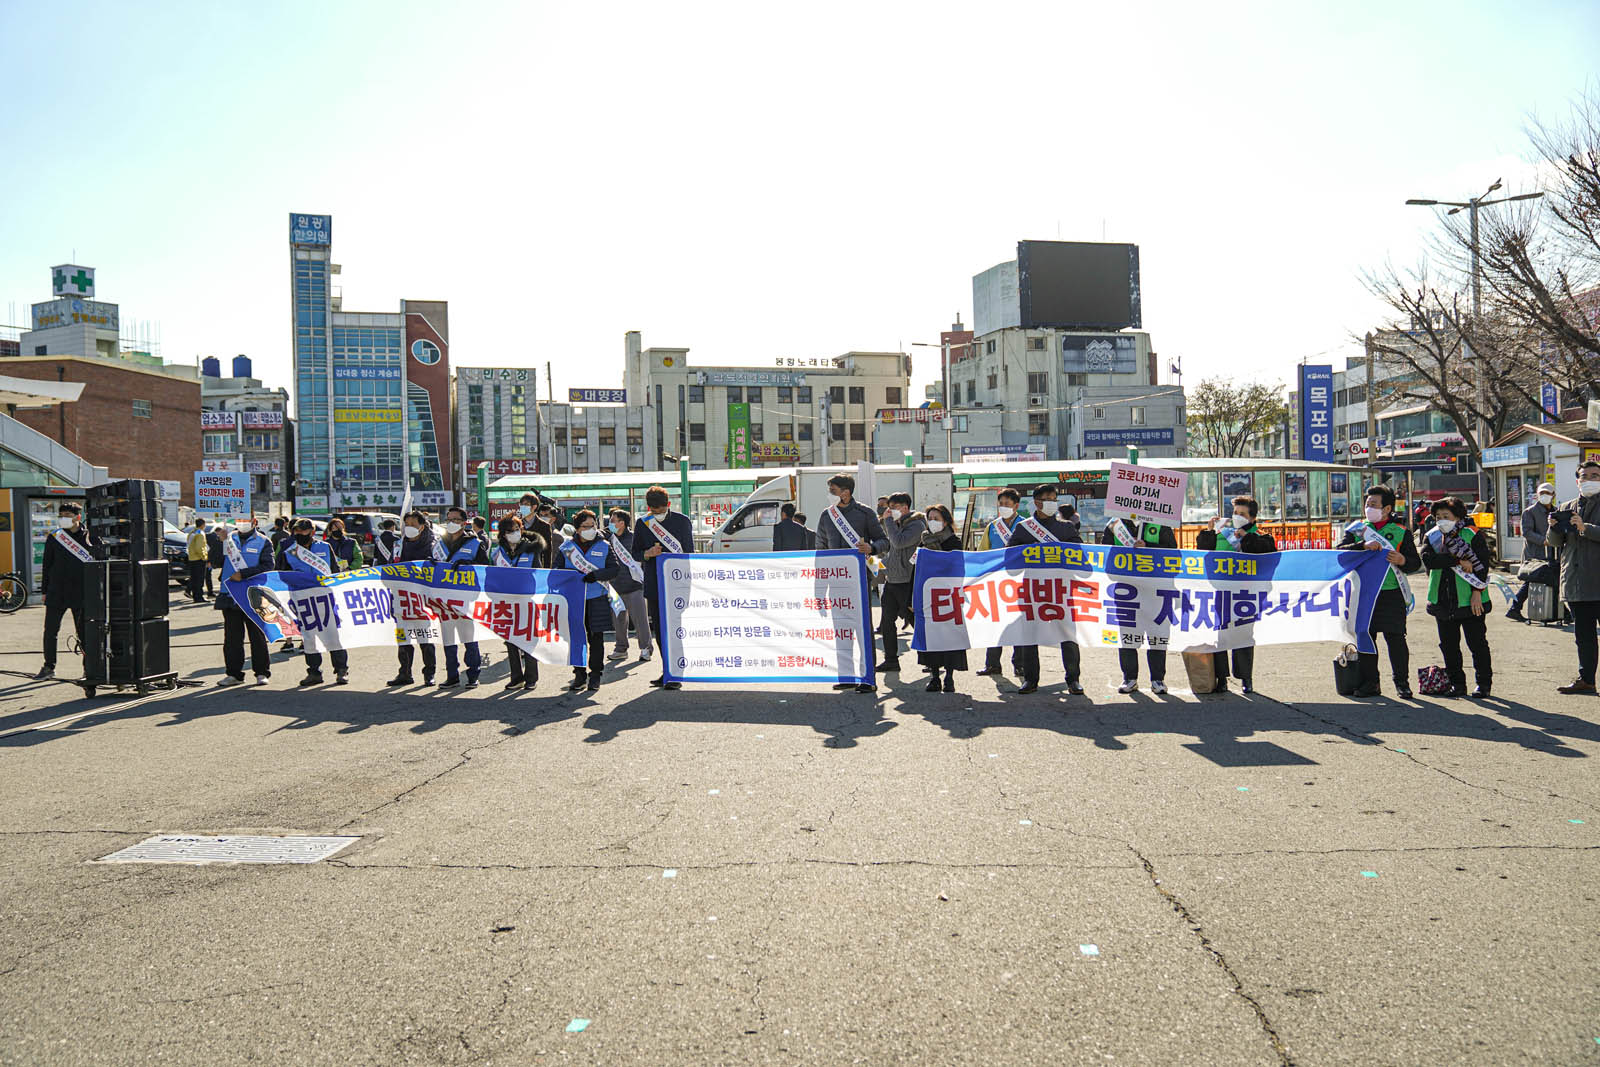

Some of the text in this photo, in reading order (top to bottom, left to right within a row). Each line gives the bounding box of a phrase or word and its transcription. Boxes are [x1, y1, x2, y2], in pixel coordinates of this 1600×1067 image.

[584, 390, 624, 402] 대명장
[1311, 387, 1328, 454] 목포역
[199, 477, 232, 486] 사적모임은
[1117, 468, 1180, 488] 코로나19 확산!
[1132, 485, 1160, 499] 여기서
[710, 503, 733, 515] 택시
[1114, 495, 1174, 515] 막아야 합니다.
[1022, 546, 1104, 569] 연말연시
[1214, 557, 1257, 576] 자제
[441, 569, 476, 586] 자제
[708, 569, 735, 581] 이동과
[738, 569, 765, 580] 모임을
[800, 567, 852, 580] 자제합시다.
[730, 598, 768, 609] 마스크를
[803, 597, 855, 610] 착용합시다.
[343, 587, 398, 626] 멈춰야
[472, 600, 560, 643] 멈춥니다!
[714, 626, 742, 638] 타지역
[744, 626, 771, 638] 방문을
[805, 628, 856, 641] 자제합시다.
[715, 656, 743, 668] 백신을
[777, 656, 828, 668] 접종합시다.
